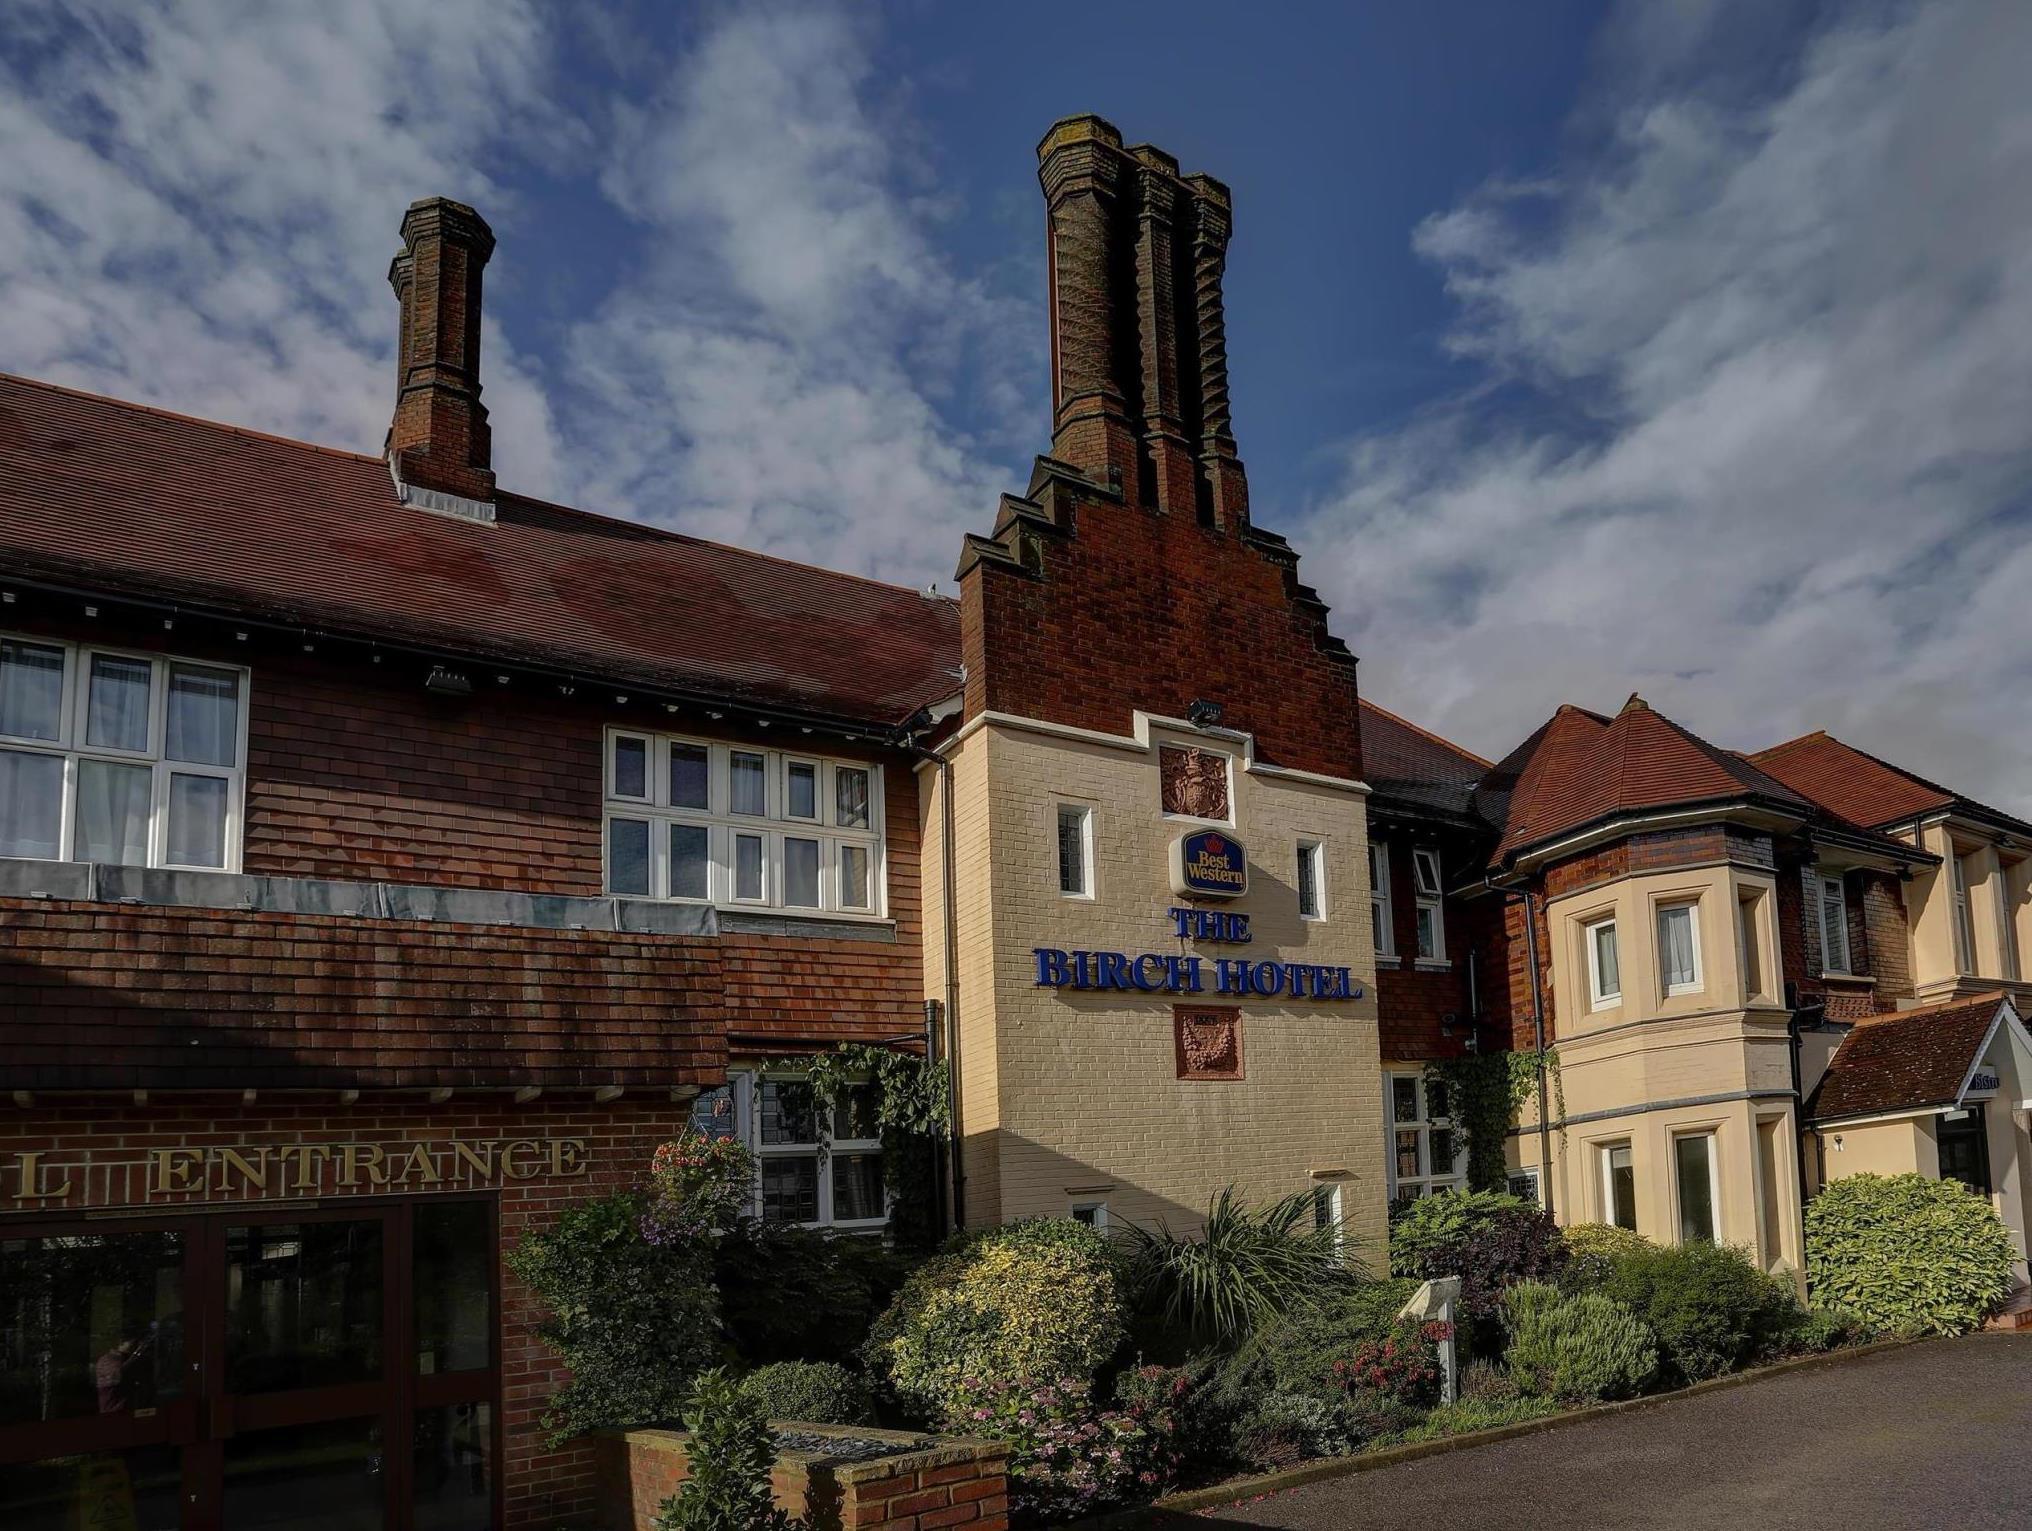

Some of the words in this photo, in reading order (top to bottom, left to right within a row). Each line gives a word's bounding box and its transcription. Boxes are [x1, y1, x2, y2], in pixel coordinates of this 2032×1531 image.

[1187, 862, 1243, 884] Western
[1199, 850, 1230, 870] Best
[1167, 905, 1252, 943] THE
[1033, 948, 1204, 993] BIRCH
[1215, 958, 1363, 999] HOTEL
[150, 1138, 588, 1194] ENTRANCE
